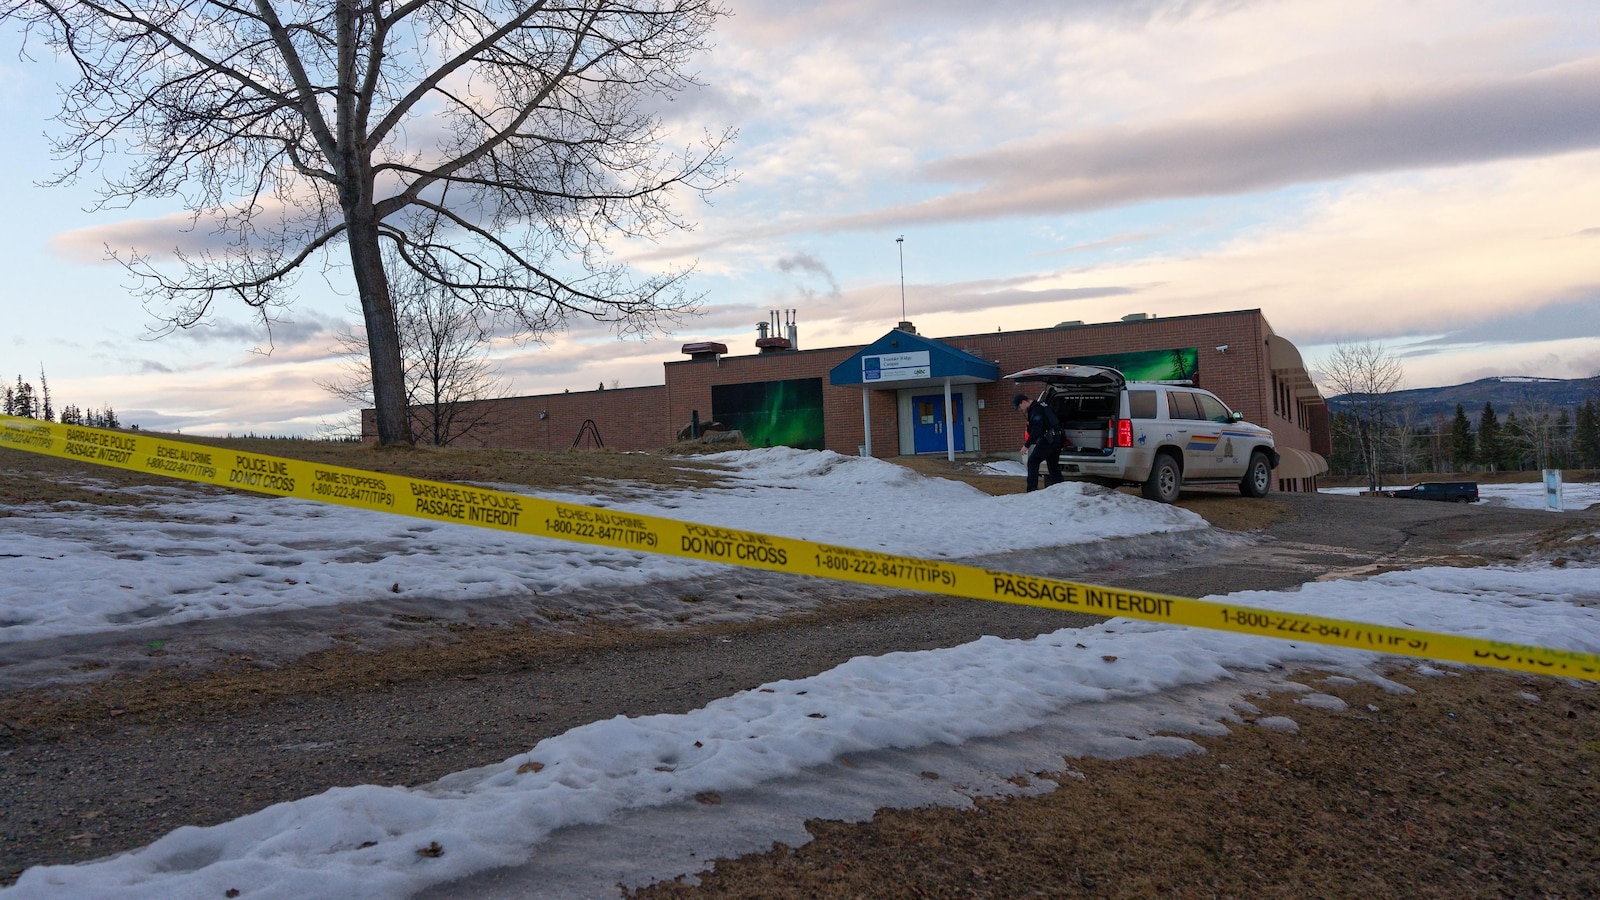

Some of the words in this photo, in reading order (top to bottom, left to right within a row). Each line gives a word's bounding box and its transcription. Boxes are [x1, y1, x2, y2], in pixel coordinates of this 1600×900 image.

[67, 429, 99, 444] BARRAGE
[100, 434, 109, 446] DE
[110, 436, 136, 451] POLICE
[64, 442, 98, 458] PASSAGE
[97, 447, 132, 464] INTERDIT
[180, 450, 189, 461] AU
[190, 451, 212, 465] CRIME
[236, 455, 267, 472] POLICE
[268, 460, 288, 476] LINE
[229, 469, 244, 483] DO
[244, 471, 263, 486] NOT
[263, 474, 295, 492] CROSS
[315, 470, 340, 484] CRIME
[341, 474, 386, 491] STOPPERS
[410, 482, 463, 503] BARRAGE
[462, 490, 480, 505] DE
[479, 493, 523, 511] POLICE
[416, 498, 465, 519] PASSAGE
[468, 506, 520, 527] INTERDIT
[595, 513, 610, 525] AU
[611, 515, 647, 530] CRIME
[681, 535, 702, 553] DO
[704, 538, 733, 558] NOT
[736, 543, 787, 565] CROSS
[994, 577, 1079, 604] PASSAGE
[1085, 588, 1174, 617] INTERDIT
